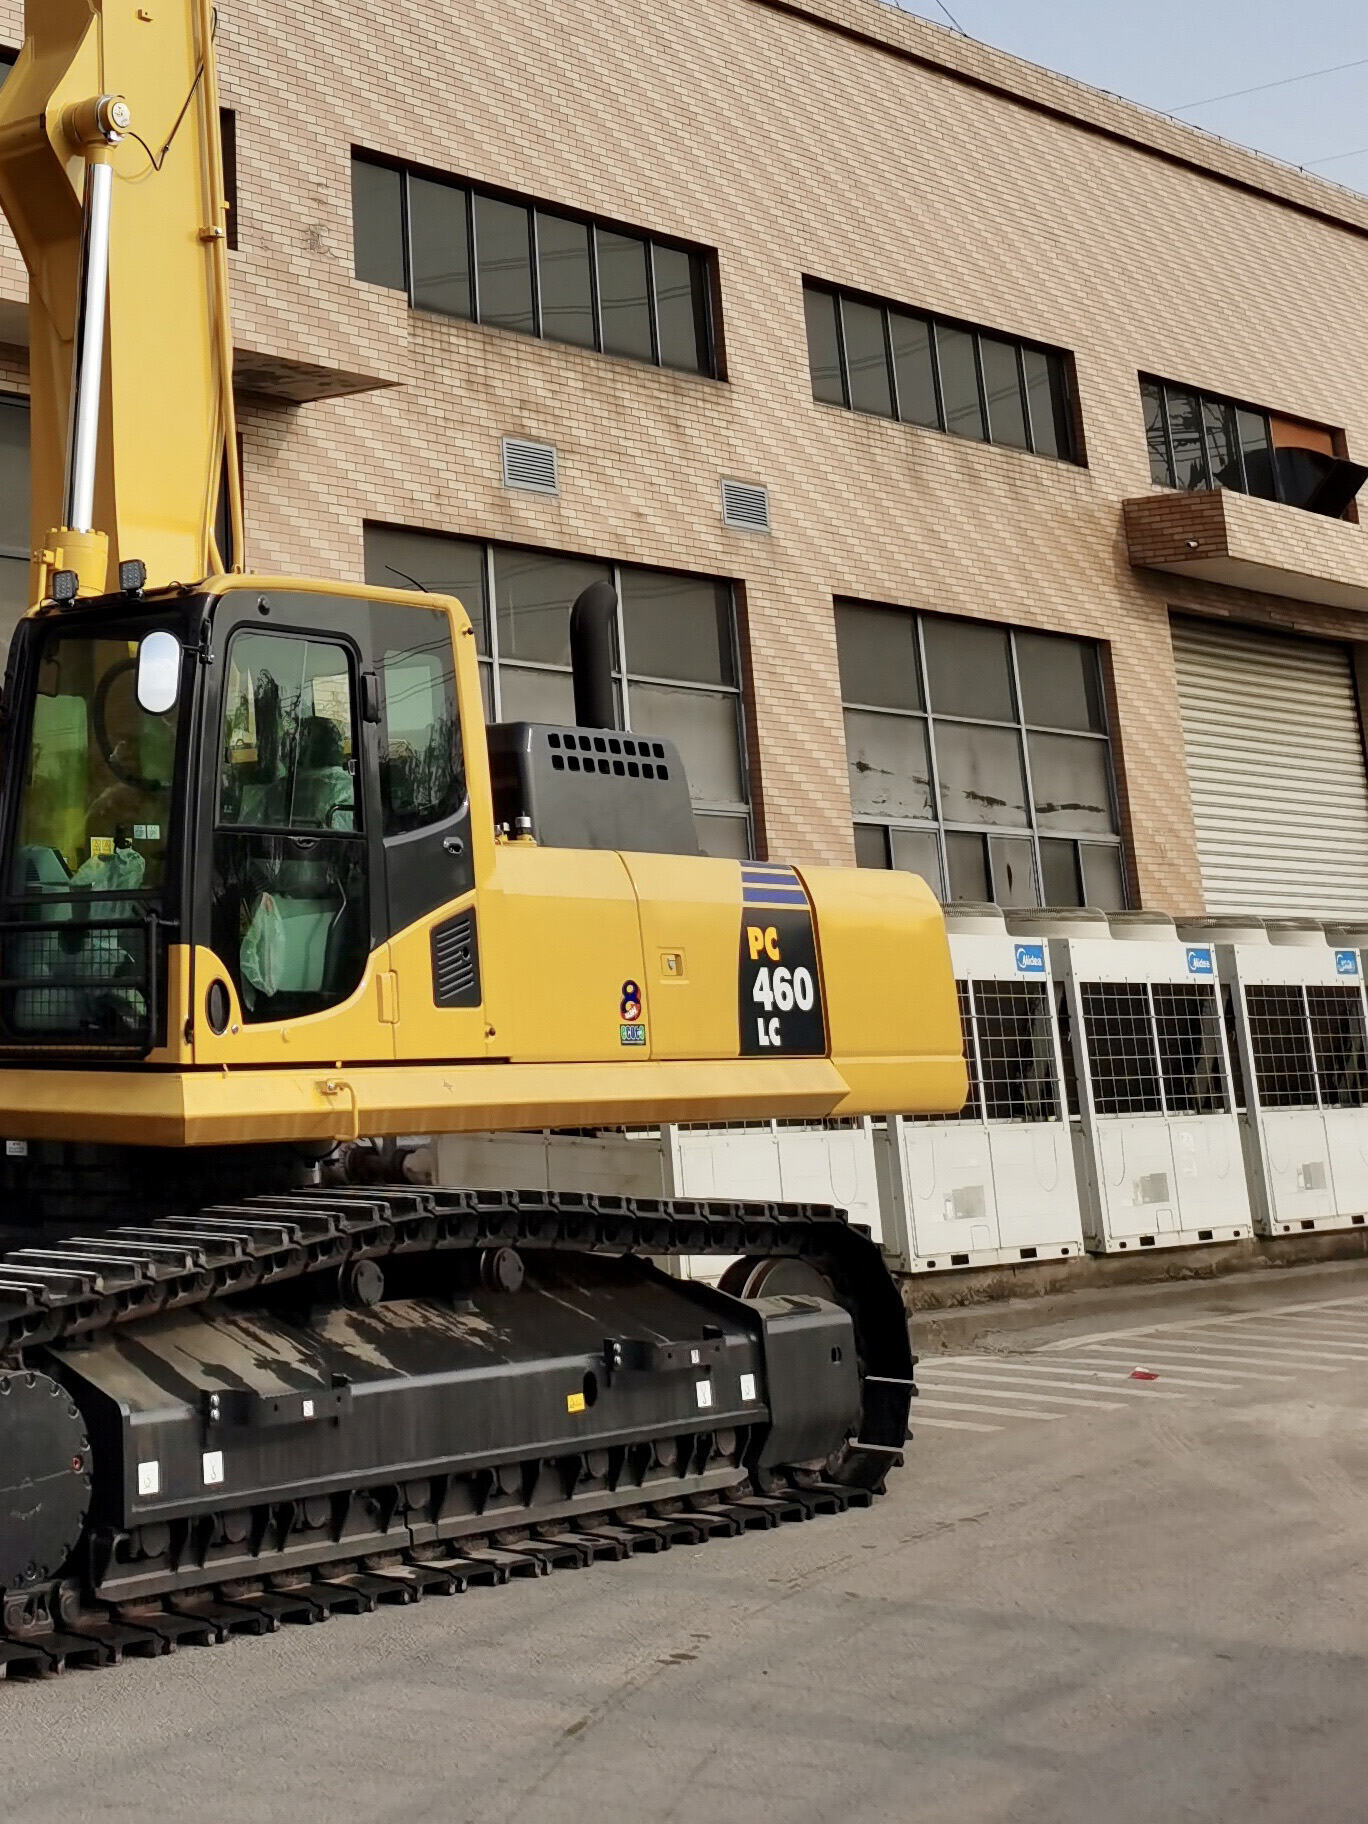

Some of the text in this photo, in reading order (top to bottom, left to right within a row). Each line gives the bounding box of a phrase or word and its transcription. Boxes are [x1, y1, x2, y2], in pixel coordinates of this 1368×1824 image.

[747, 926, 780, 961] PC
[752, 966, 814, 1011] 460
[757, 1017, 781, 1046] LC
